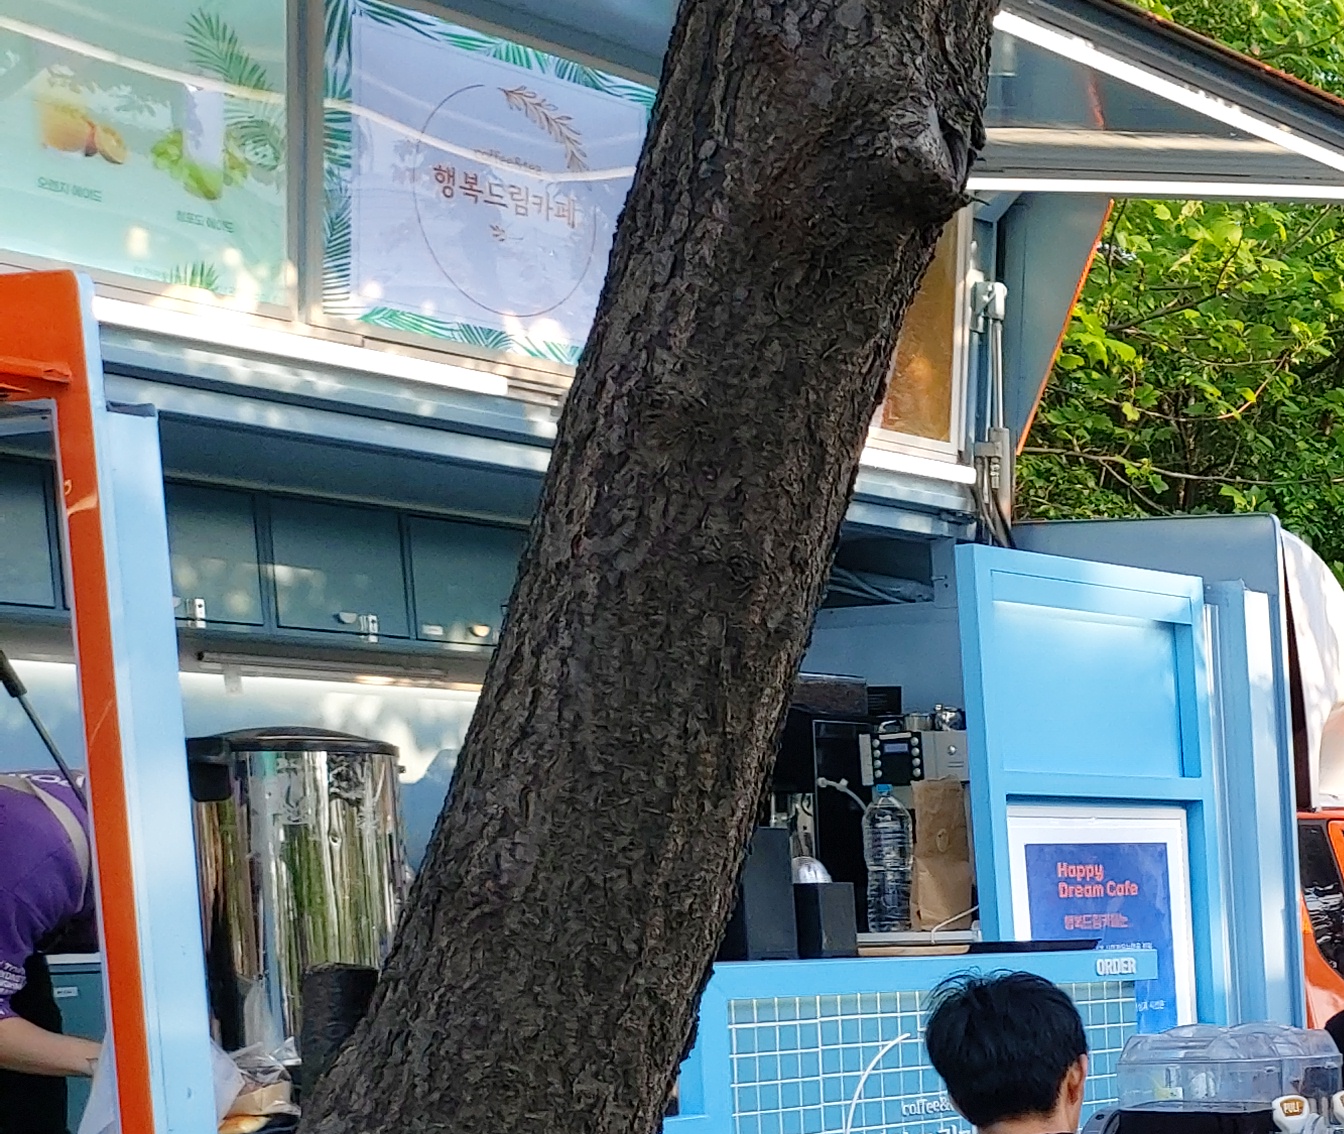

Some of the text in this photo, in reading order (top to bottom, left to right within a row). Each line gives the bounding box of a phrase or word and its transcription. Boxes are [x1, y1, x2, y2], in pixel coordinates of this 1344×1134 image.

[37, 176, 70, 195] 오렌지
[432, 164, 576, 229] 행복드림카페
[1057, 862, 1105, 882] Happy
[1058, 880, 1139, 898] Dream Cafe
[1096, 956, 1137, 976] ORDER
